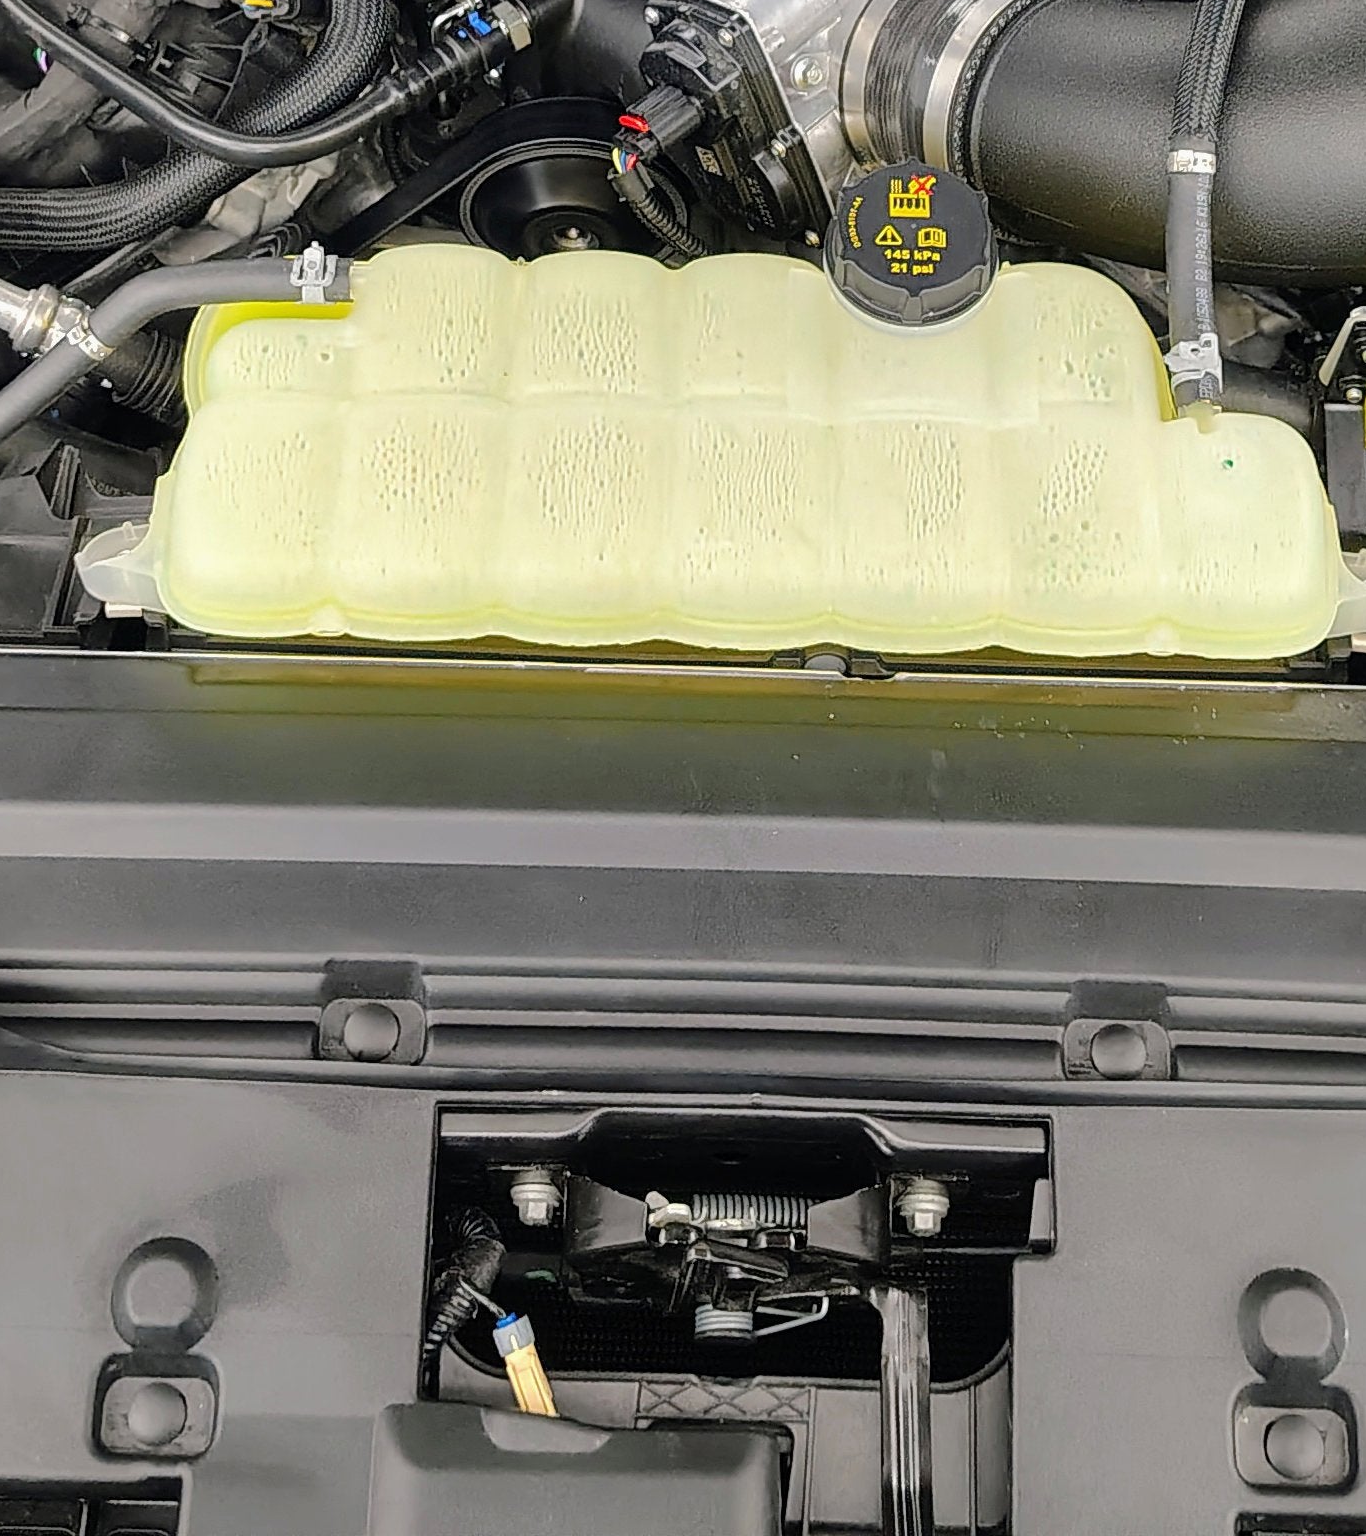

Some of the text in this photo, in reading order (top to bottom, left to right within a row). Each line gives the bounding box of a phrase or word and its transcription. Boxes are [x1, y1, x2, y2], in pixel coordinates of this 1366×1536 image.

[884, 250, 941, 261] 145 kPa
[891, 264, 933, 275] 21 psi
